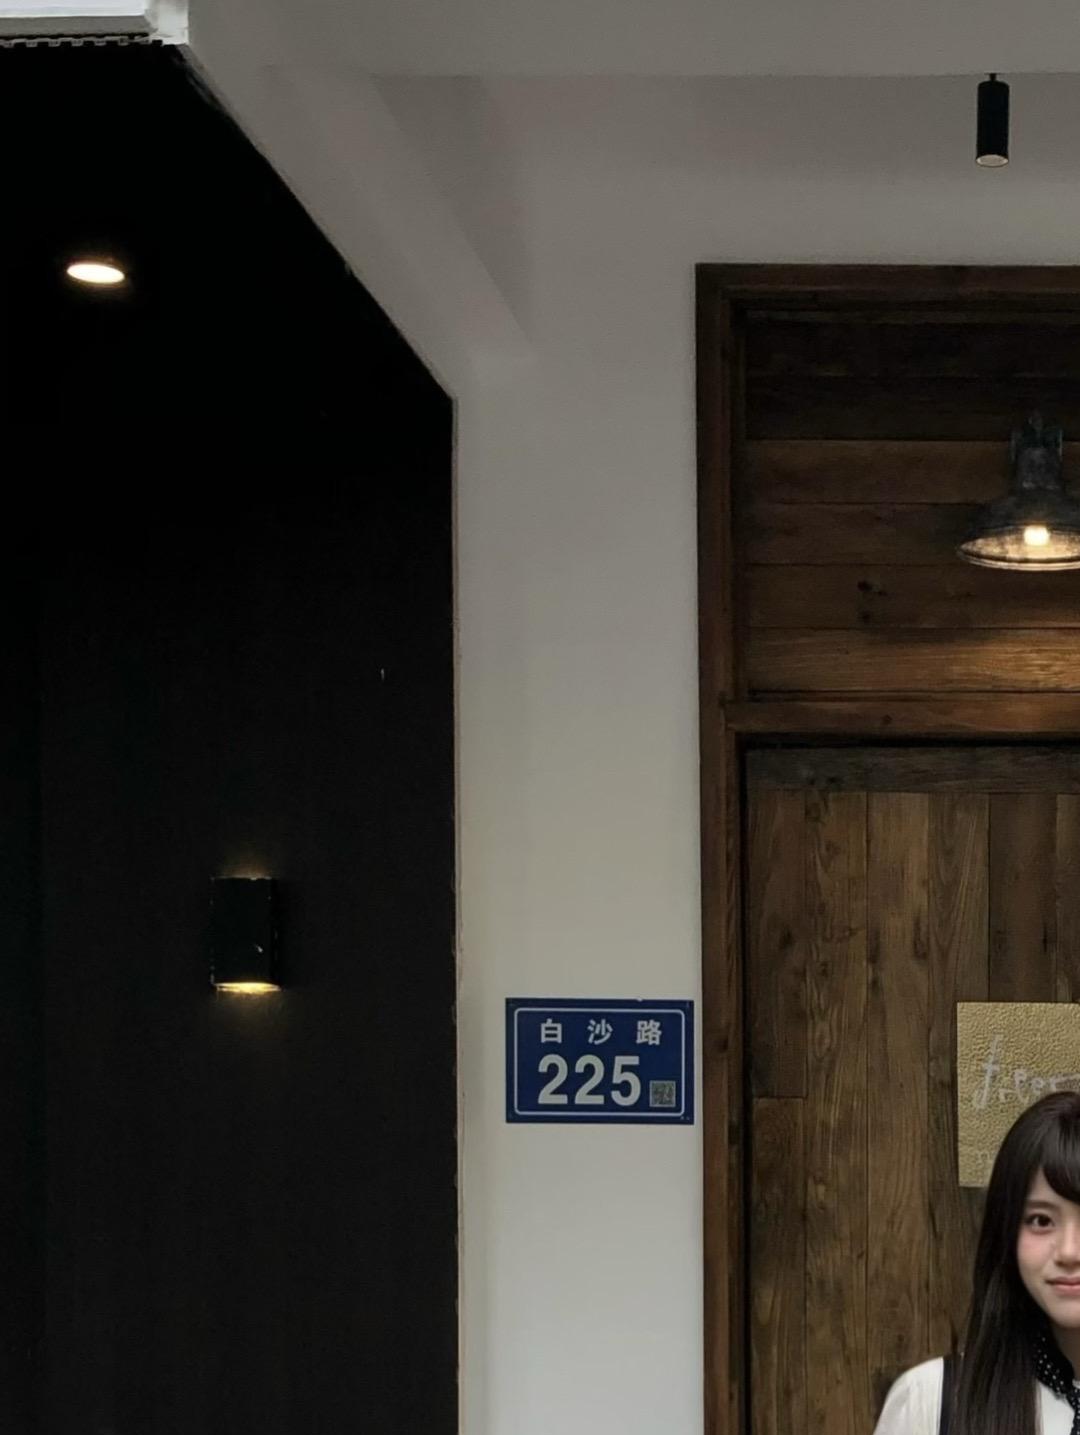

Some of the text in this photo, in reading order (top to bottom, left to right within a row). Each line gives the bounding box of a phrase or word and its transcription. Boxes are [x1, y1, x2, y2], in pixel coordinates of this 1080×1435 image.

[540, 1018, 662, 1045] 白沙路
[538, 1054, 641, 1106] 225
